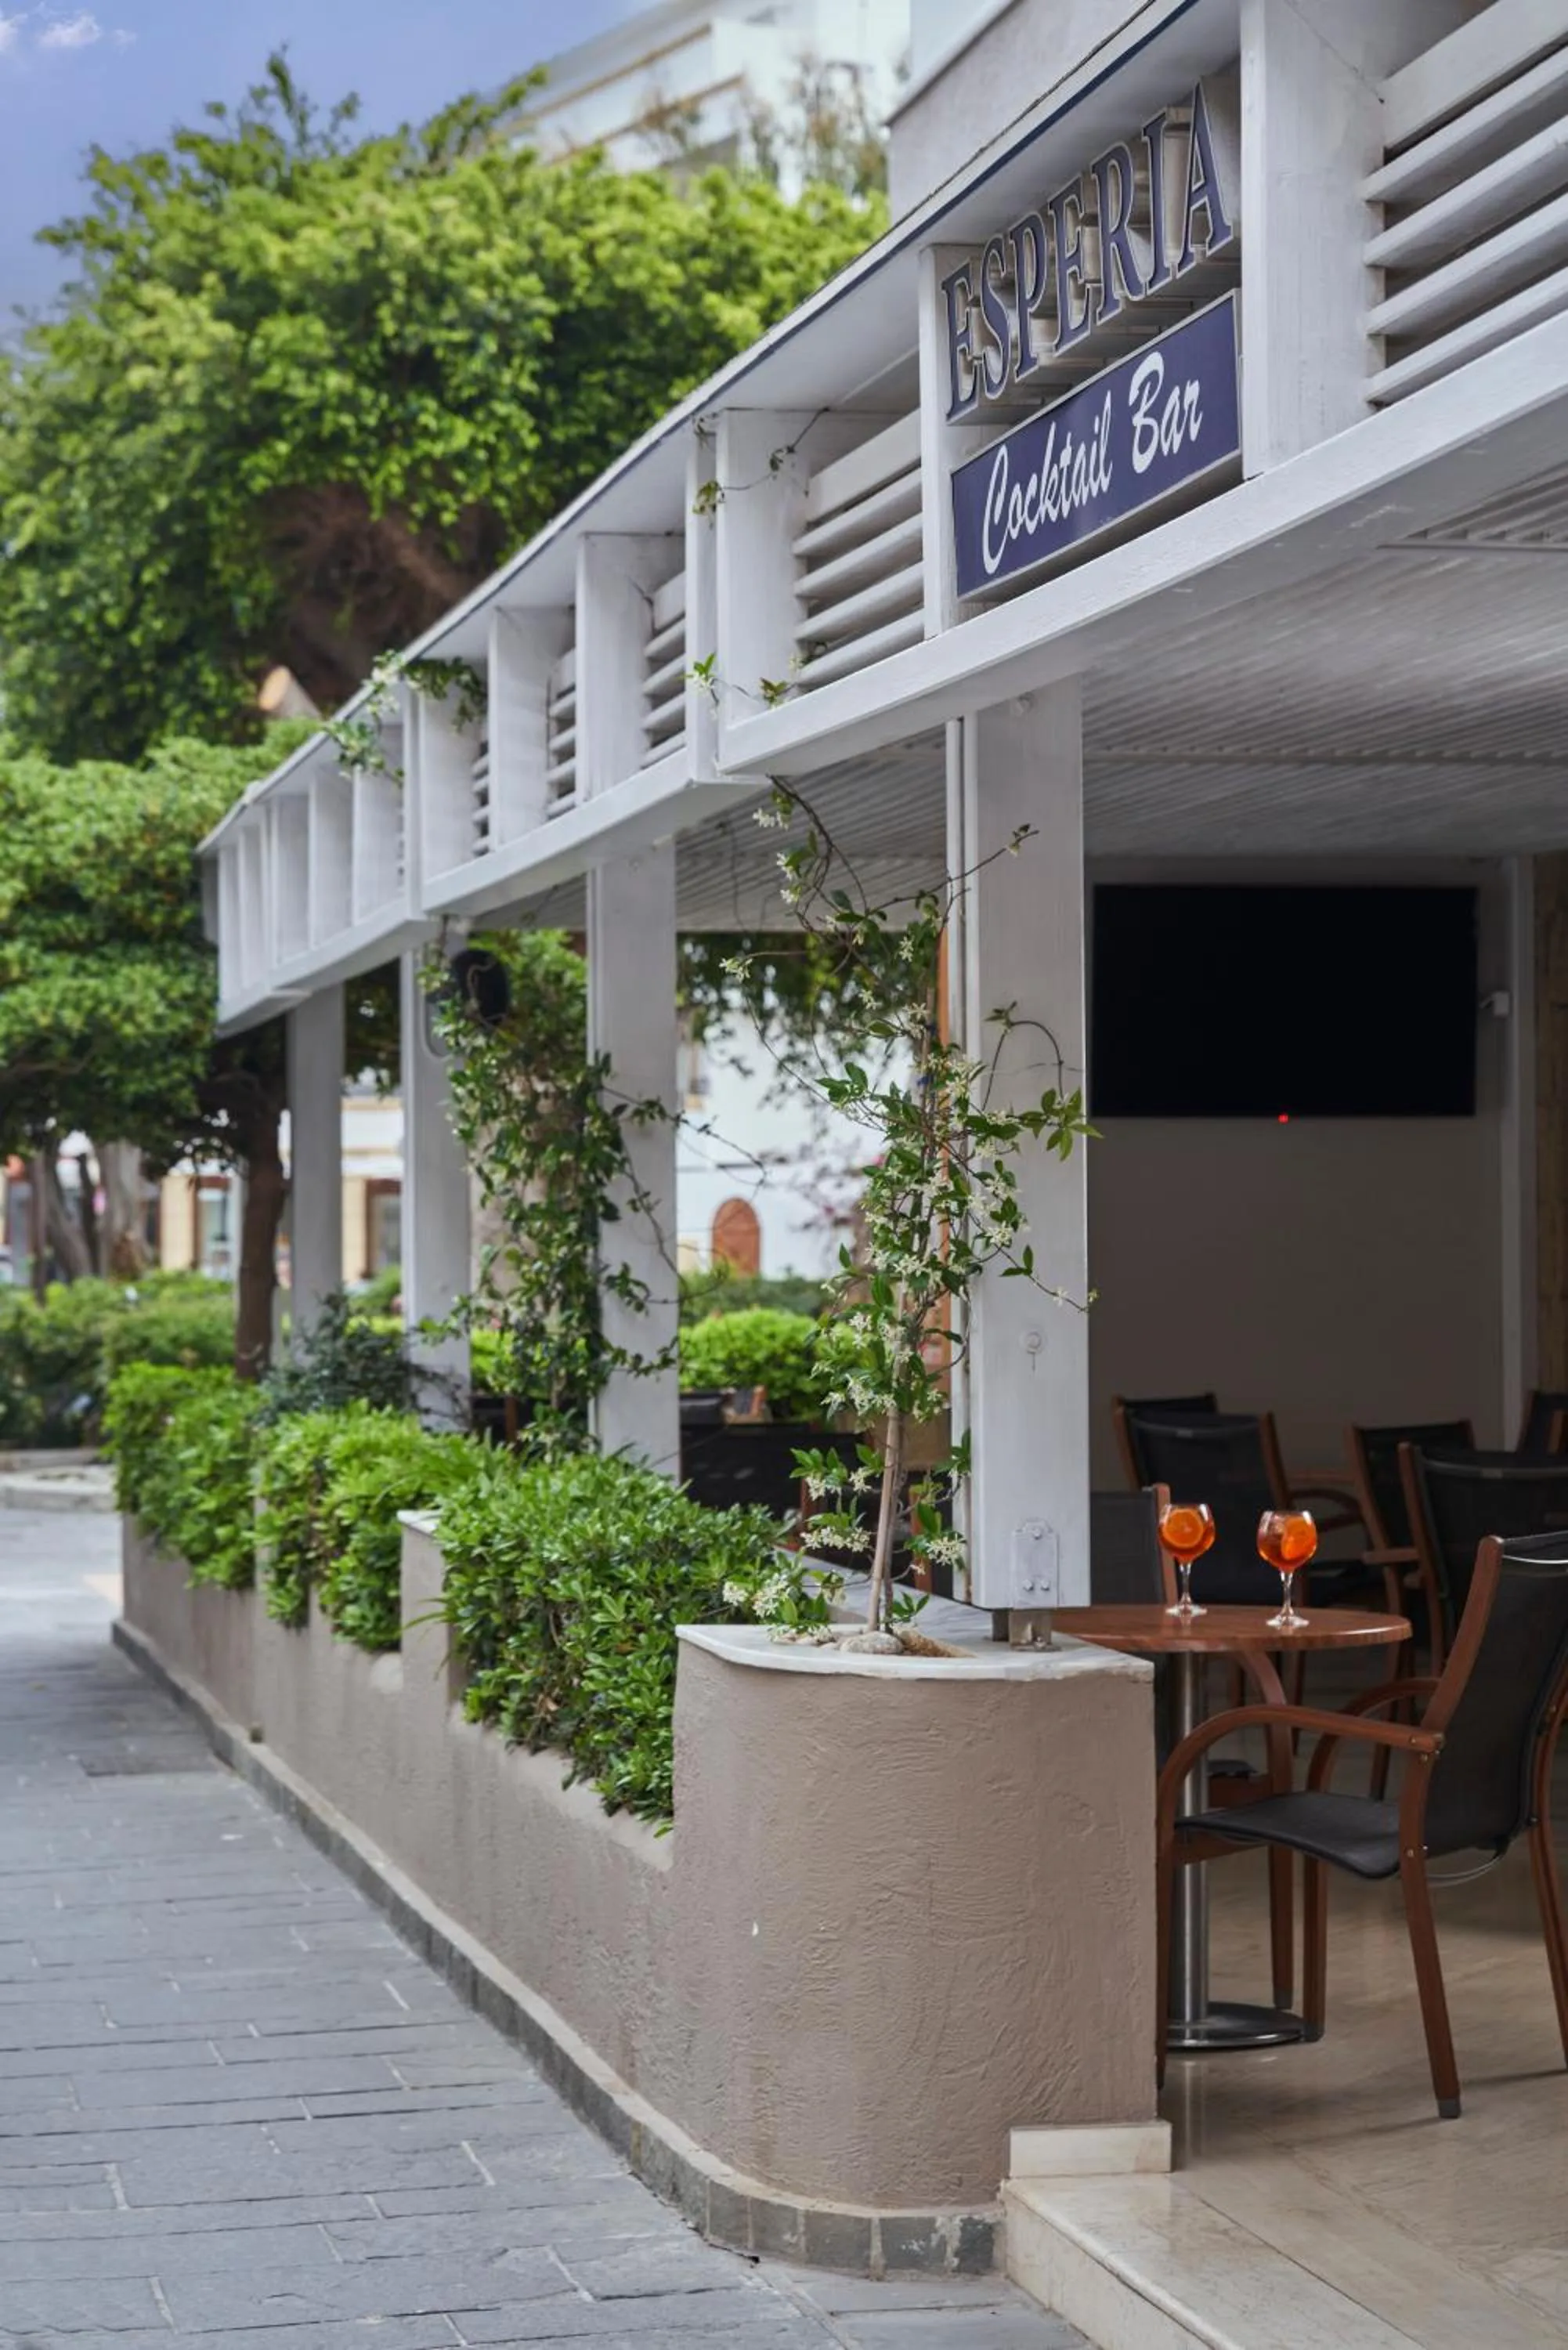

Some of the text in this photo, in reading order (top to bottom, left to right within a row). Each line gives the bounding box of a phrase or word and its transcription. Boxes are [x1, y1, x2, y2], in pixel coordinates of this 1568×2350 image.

[941, 82, 1233, 424] ESPERIA
[982, 352, 1203, 574] Cocktail Bar
